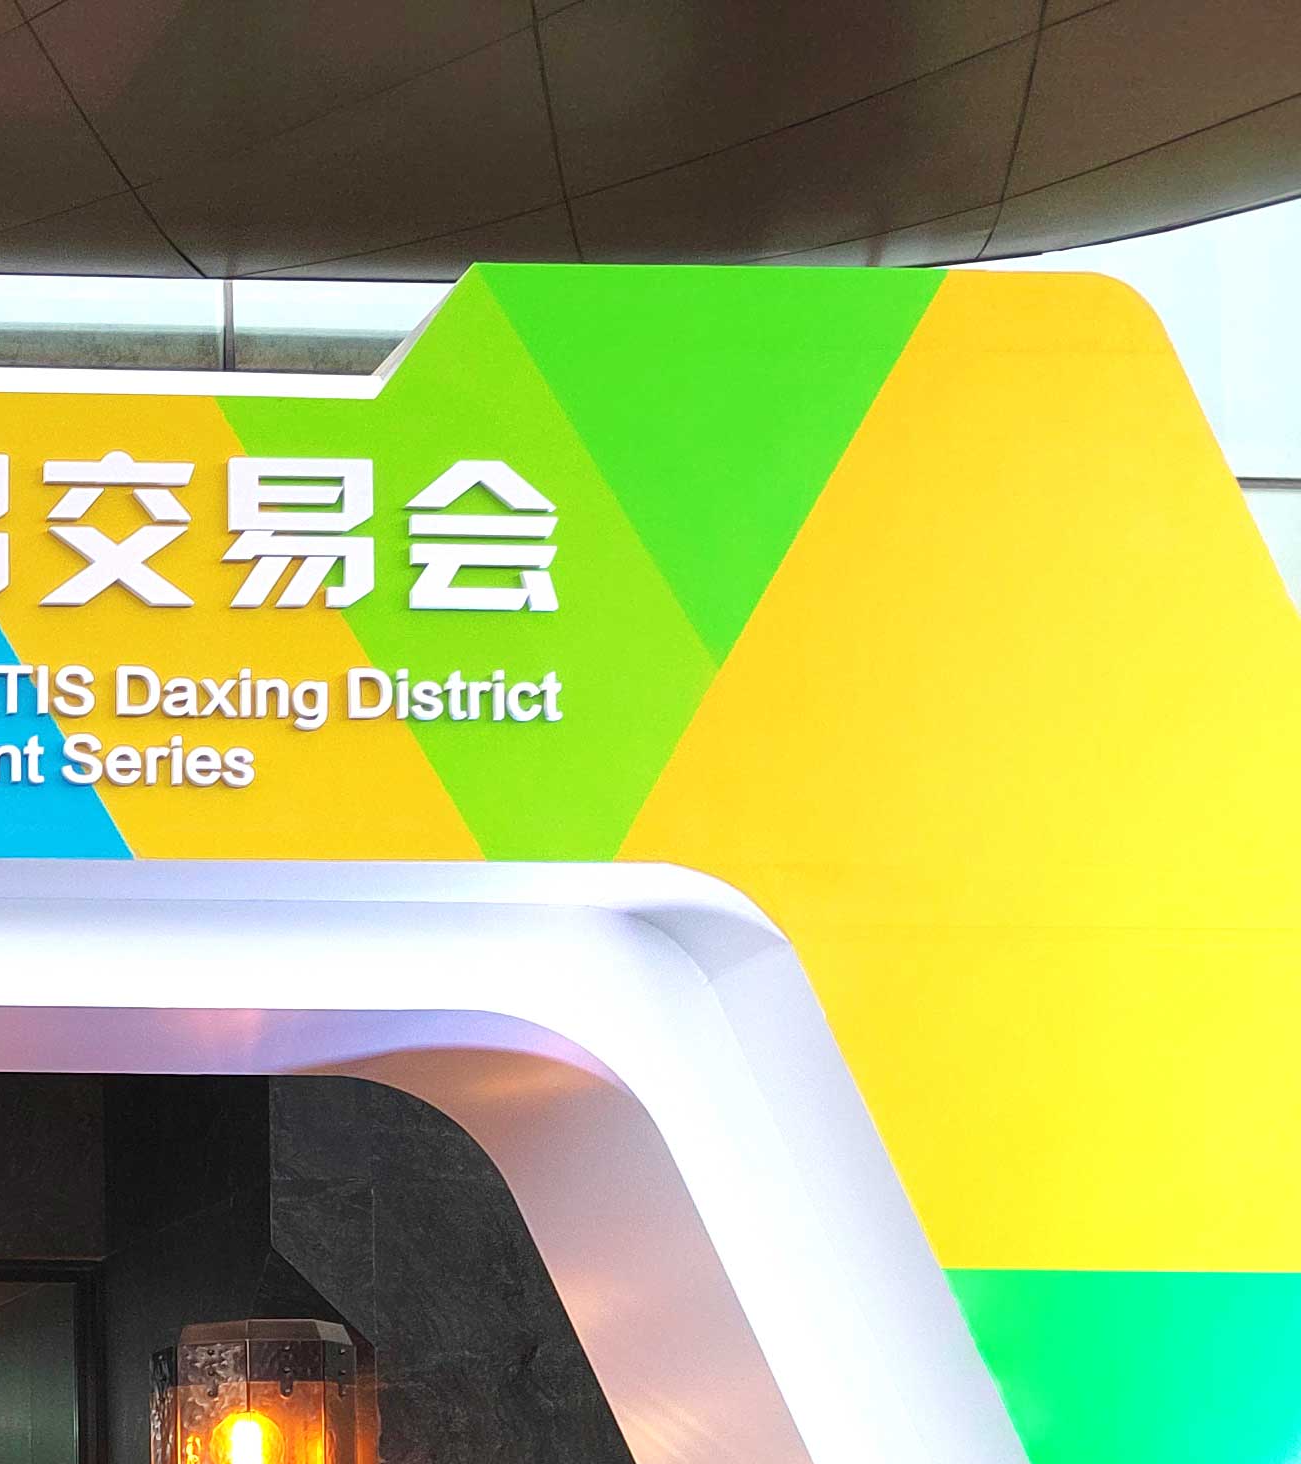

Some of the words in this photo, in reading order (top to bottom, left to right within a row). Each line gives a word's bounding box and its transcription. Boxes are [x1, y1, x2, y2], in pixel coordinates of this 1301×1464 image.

[114, 665, 329, 732] Daxing
[346, 667, 564, 722] District
[60, 733, 256, 788] Series
